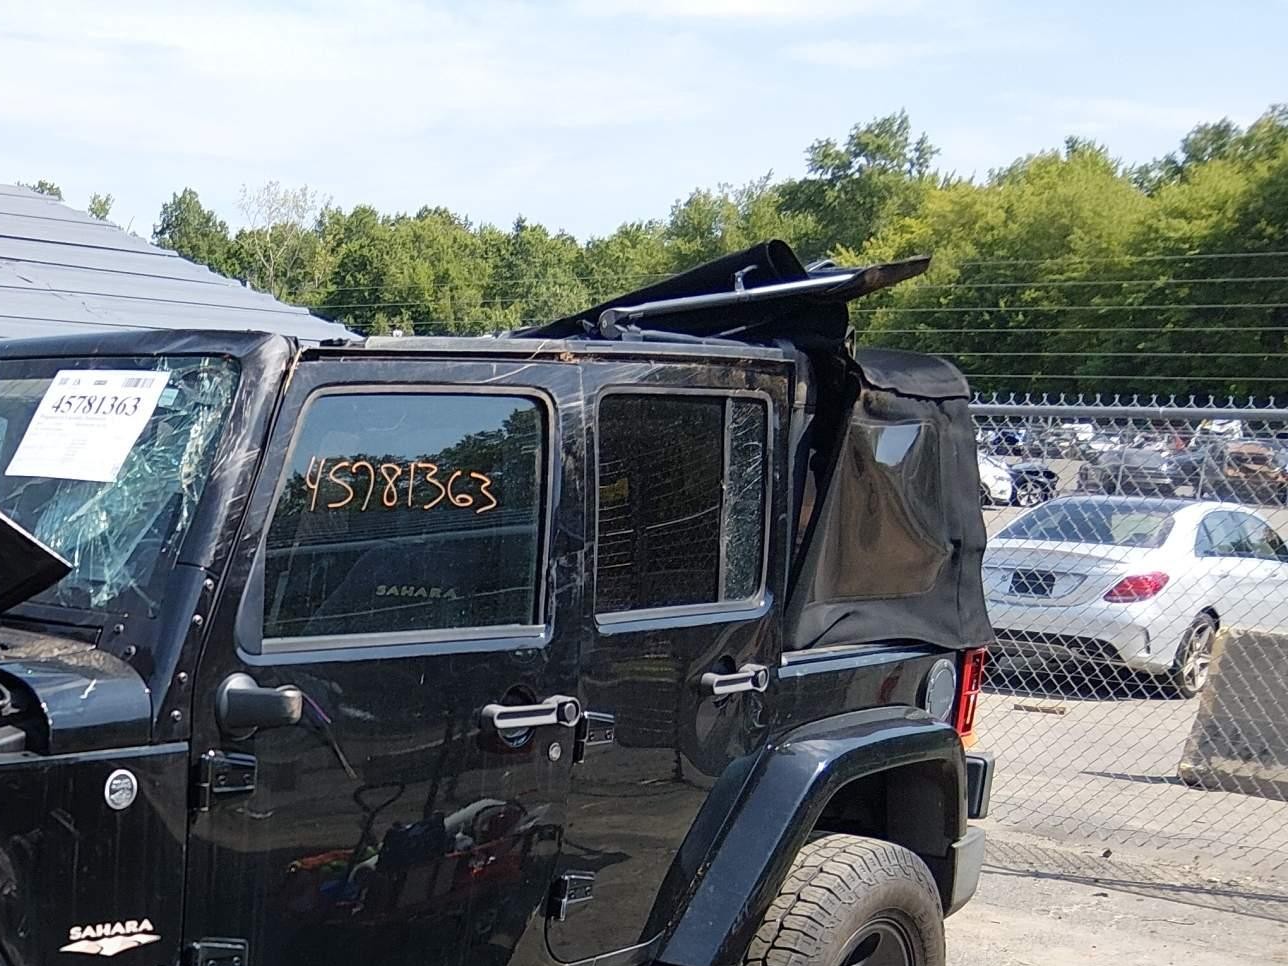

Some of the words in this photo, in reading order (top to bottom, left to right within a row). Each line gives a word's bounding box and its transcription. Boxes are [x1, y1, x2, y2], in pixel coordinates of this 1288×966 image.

[51, 395, 142, 417] 45781363
[305, 455, 498, 514] 45781363
[374, 584, 458, 600] SAHARA
[68, 918, 155, 941] SAHARA
